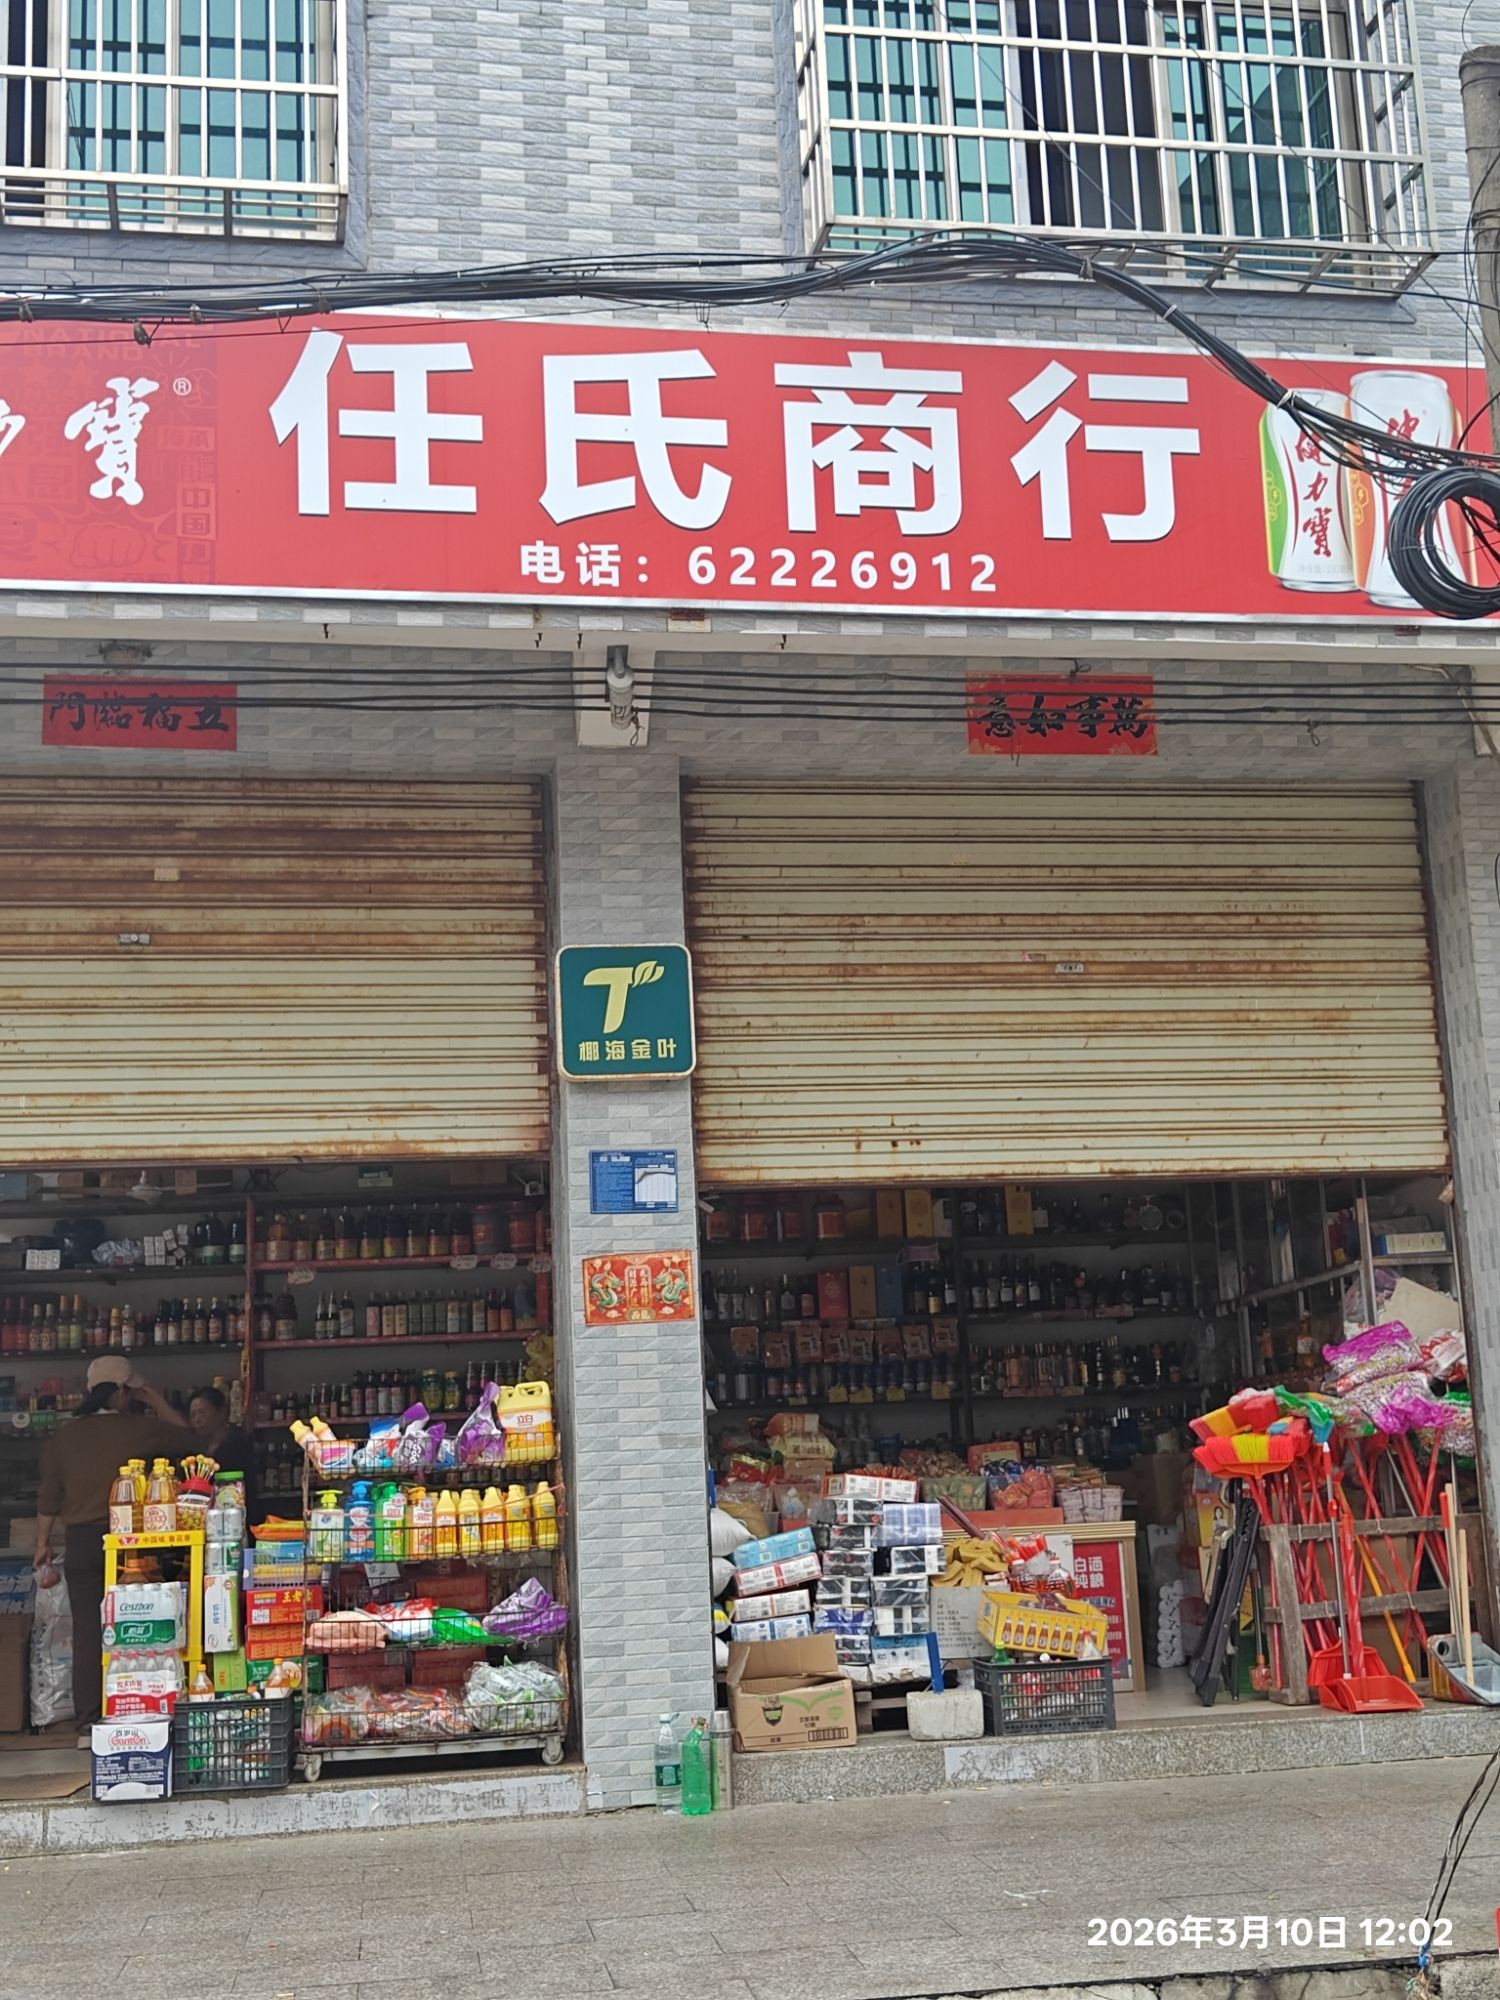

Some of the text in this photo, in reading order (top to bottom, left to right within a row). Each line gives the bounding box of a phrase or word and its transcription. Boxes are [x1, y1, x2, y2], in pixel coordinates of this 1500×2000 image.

[268, 326, 1202, 541] 任氏商行
[687, 545, 997, 593] 62226912
[578, 1038, 677, 1062] 椰海金叶
[1074, 1556, 1104, 1573] 白酒
